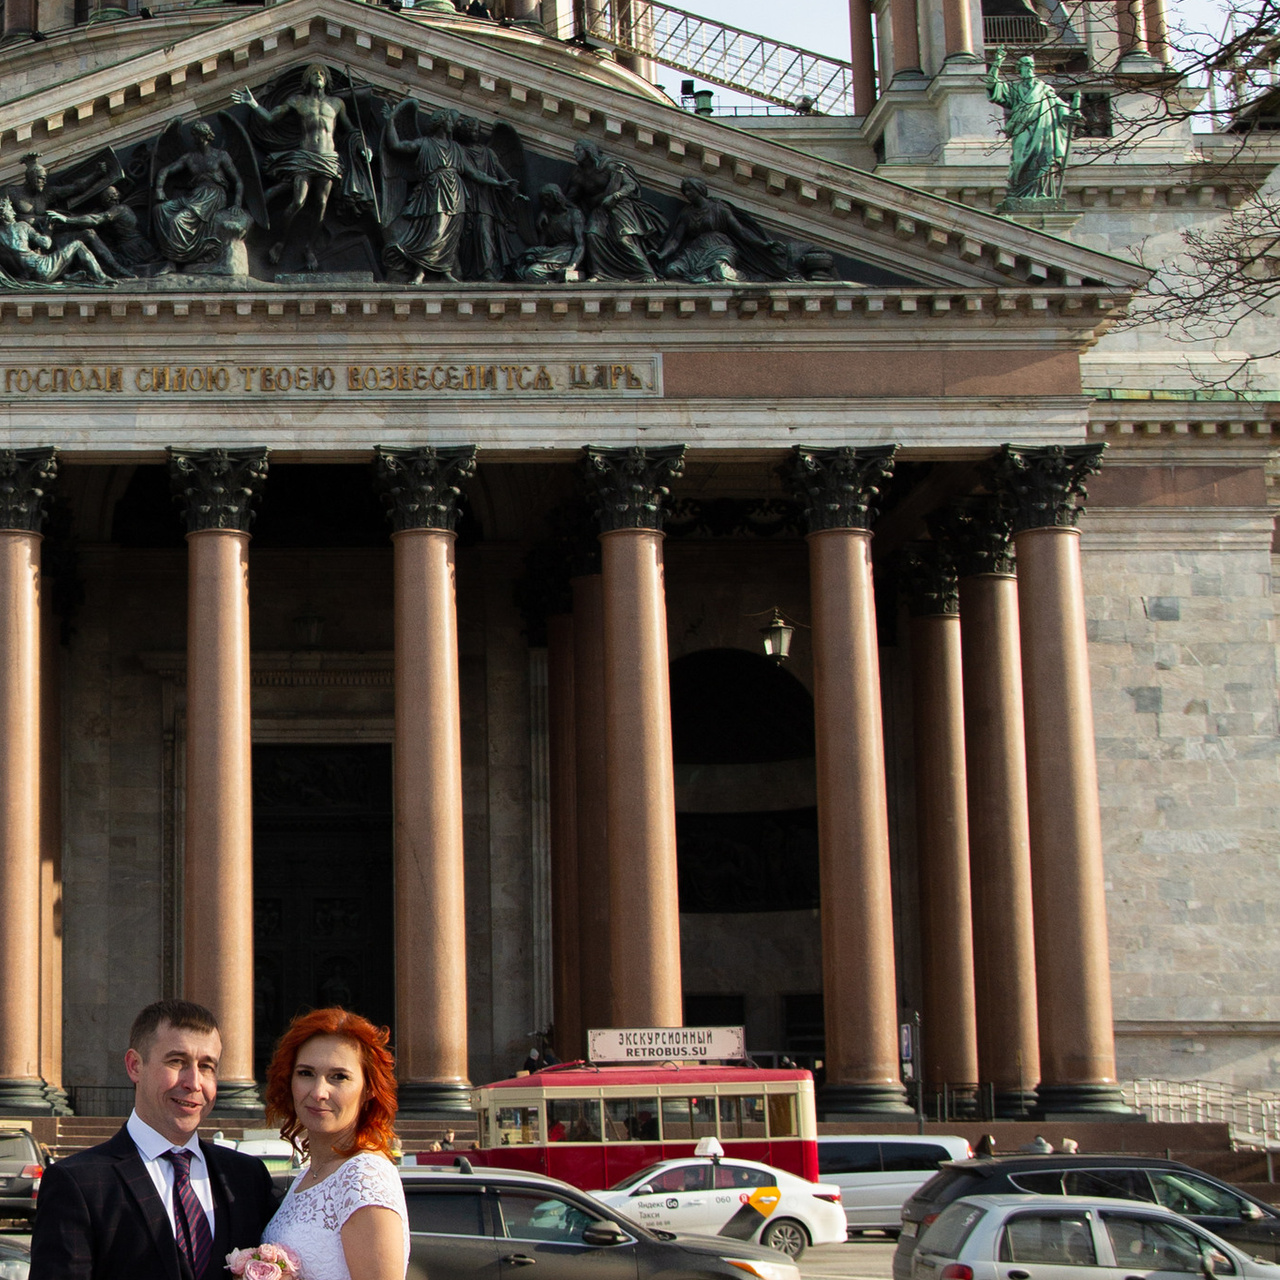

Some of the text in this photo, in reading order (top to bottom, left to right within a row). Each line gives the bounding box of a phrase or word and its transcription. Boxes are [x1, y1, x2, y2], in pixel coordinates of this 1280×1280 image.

[4, 367, 124, 393] ГОСПОДИ
[135, 366, 230, 392] СИЛОЮ
[238, 366, 336, 392] ТВОЕЮ
[618, 1030, 713, 1046] ЭКСКУРСИОННЫЙ
[626, 1046, 708, 1057] RETROBUS.SU
[637, 1199, 678, 1209] Яндекс Go
[715, 1195, 732, 1204] 060
[638, 1211, 661, 1219] Такси
